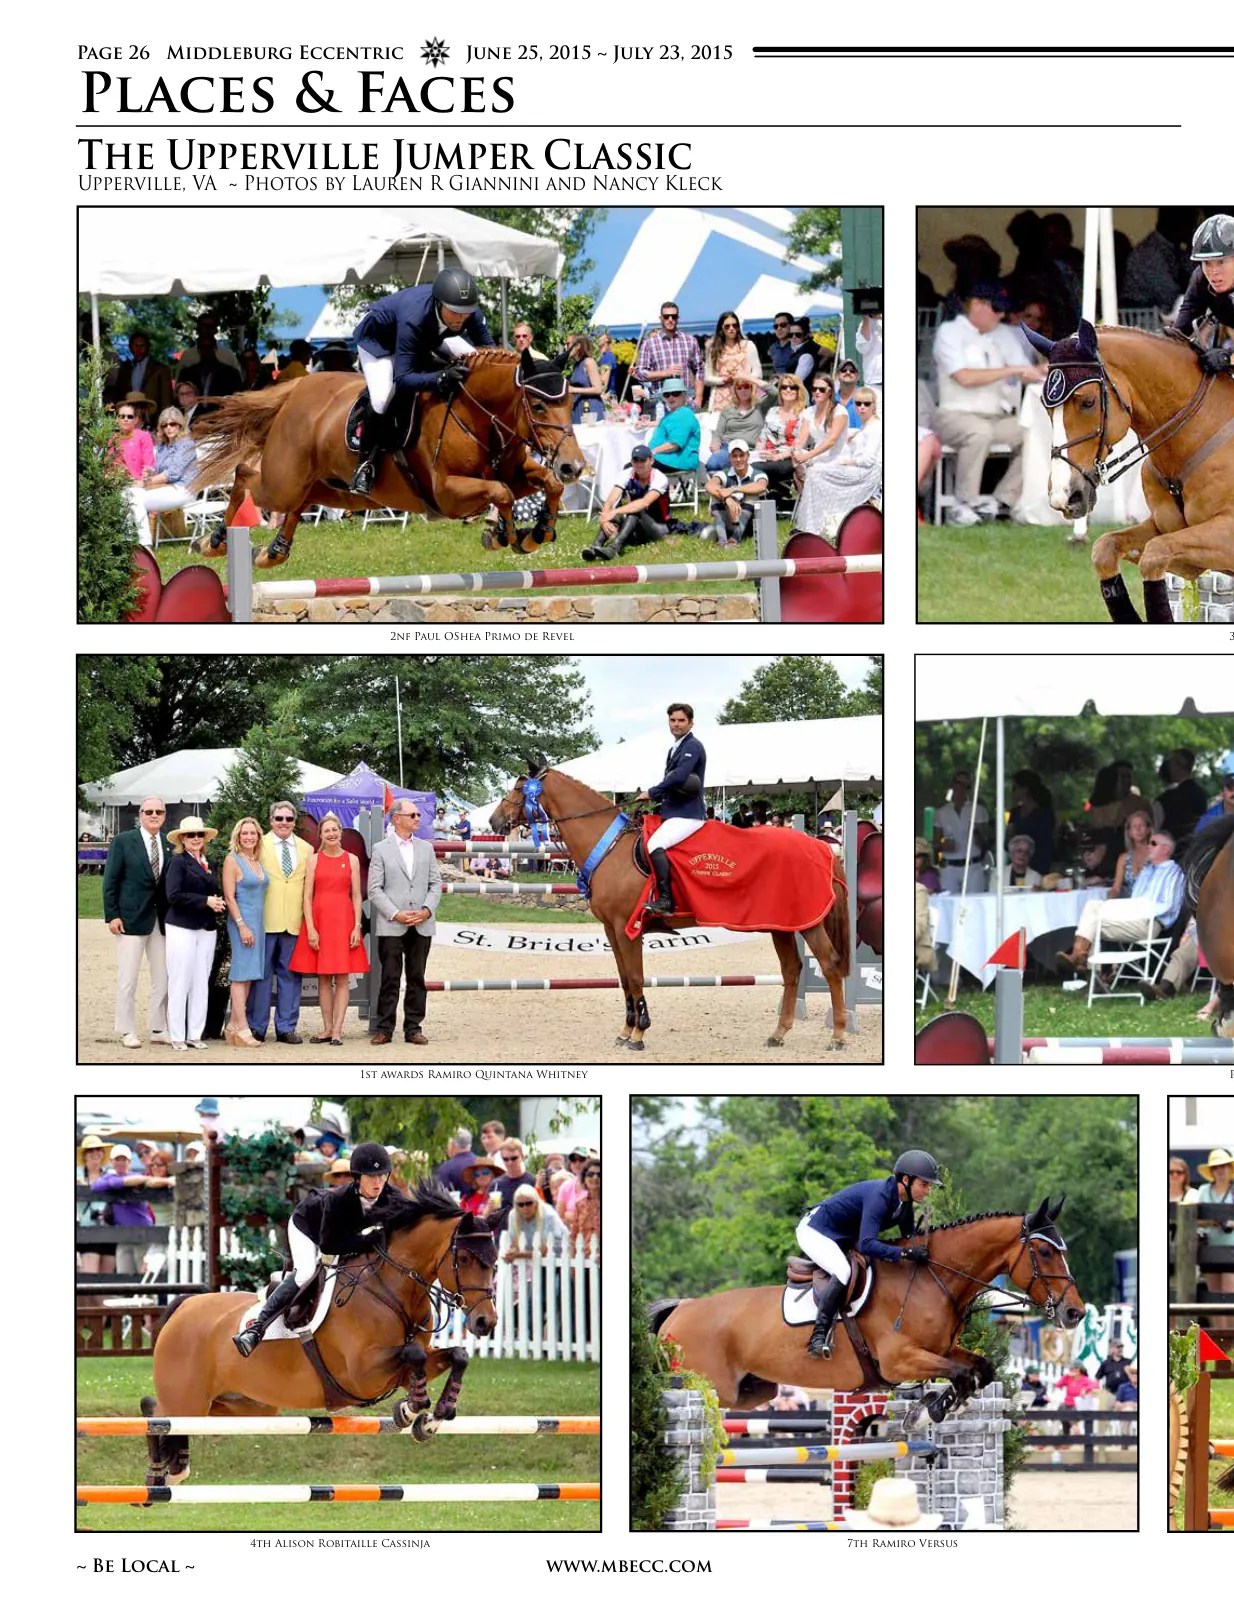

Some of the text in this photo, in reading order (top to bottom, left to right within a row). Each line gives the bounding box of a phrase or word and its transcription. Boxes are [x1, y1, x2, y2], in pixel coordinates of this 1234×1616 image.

[77, 44, 404, 60] PAGE 26 MIDDLEBURG ECCENTRIC
[466, 44, 733, 64] JUNE 25, 2015 JULY 23, 2015
[82, 67, 514, 113] PLACES & FACES
[78, 138, 691, 175] THE UPPERVILLE JUMPER CLASSIC
[78, 174, 724, 193] UPPERVILLE, VA PHOTOS BY LAUREN R GIANNINI AND NANCY KLECK
[390, 631, 575, 641] 2NF PAUL OSHEA PRIMO DE REVEL
[689, 853, 737, 869] UPPERVILLE
[453, 930, 493, 948] St.
[643, 932, 712, 949] arm
[361, 1069, 589, 1081] 1ST AWARDS RAMIRO QUINTANA WHITNEY
[249, 1538, 431, 1549] 4TH ALISON ROBITAILLE CASSINJA
[847, 1538, 958, 1548] 7TH RAMIRO VERSUS
[92, 1557, 181, 1573] BE LOCAL
